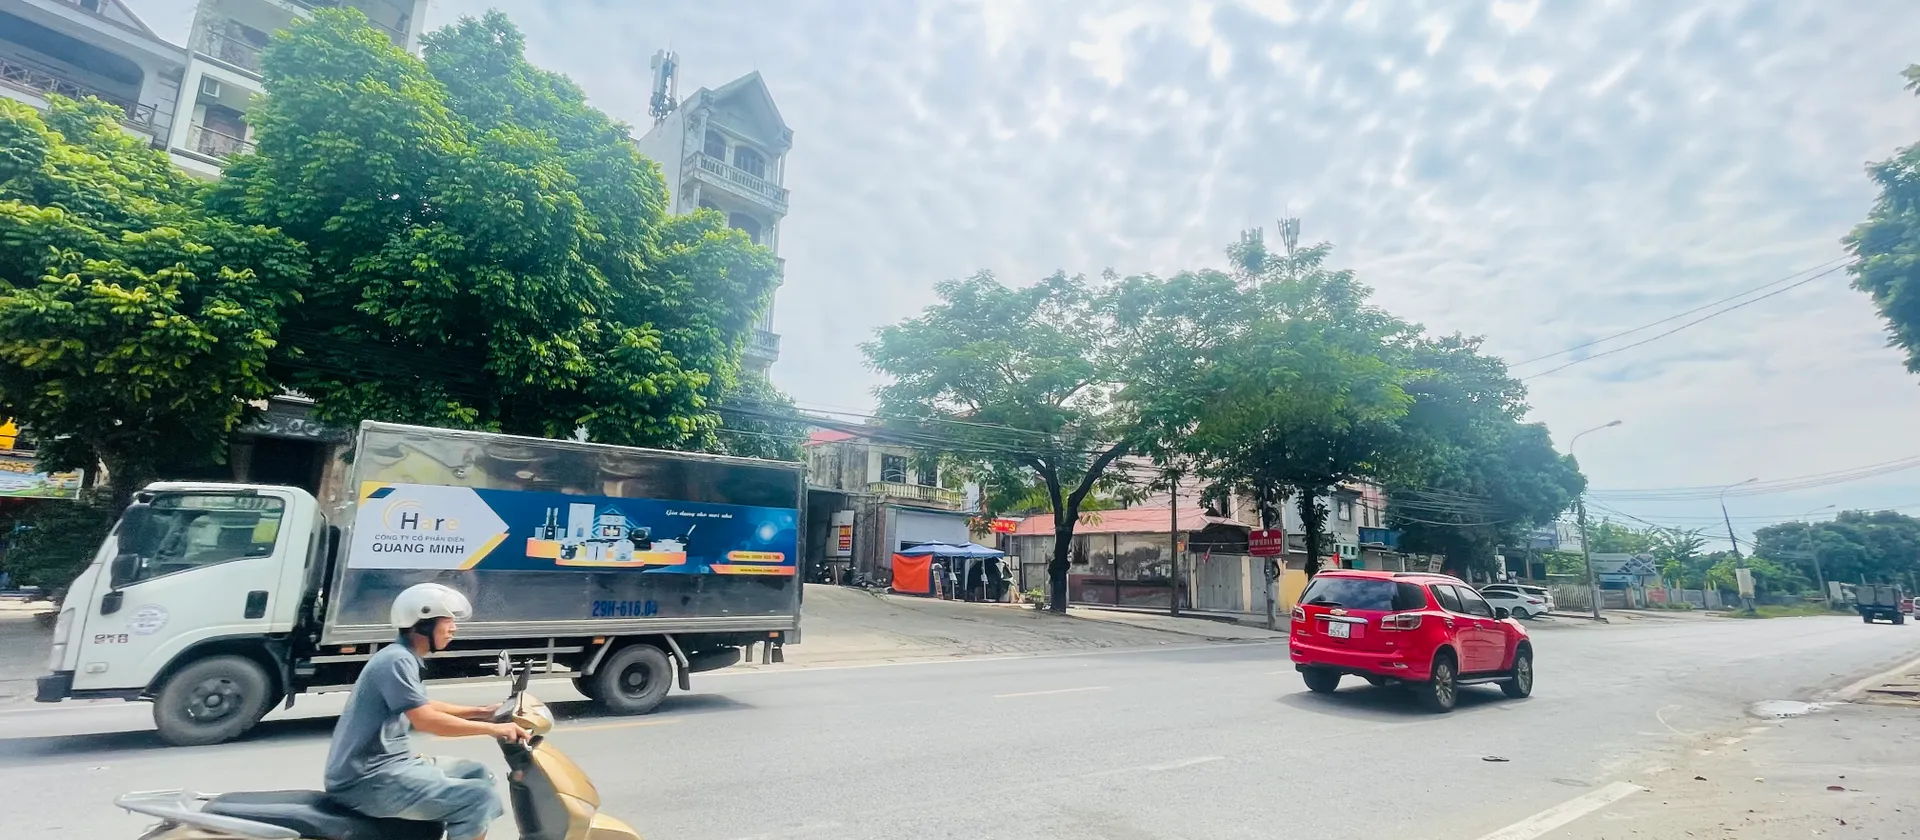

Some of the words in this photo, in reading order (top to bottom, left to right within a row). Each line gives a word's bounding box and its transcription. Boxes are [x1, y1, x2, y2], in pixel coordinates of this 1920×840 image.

[400, 512, 459, 531] Hare
[372, 542, 425, 554] QUANG
[429, 544, 464, 555] MINH
